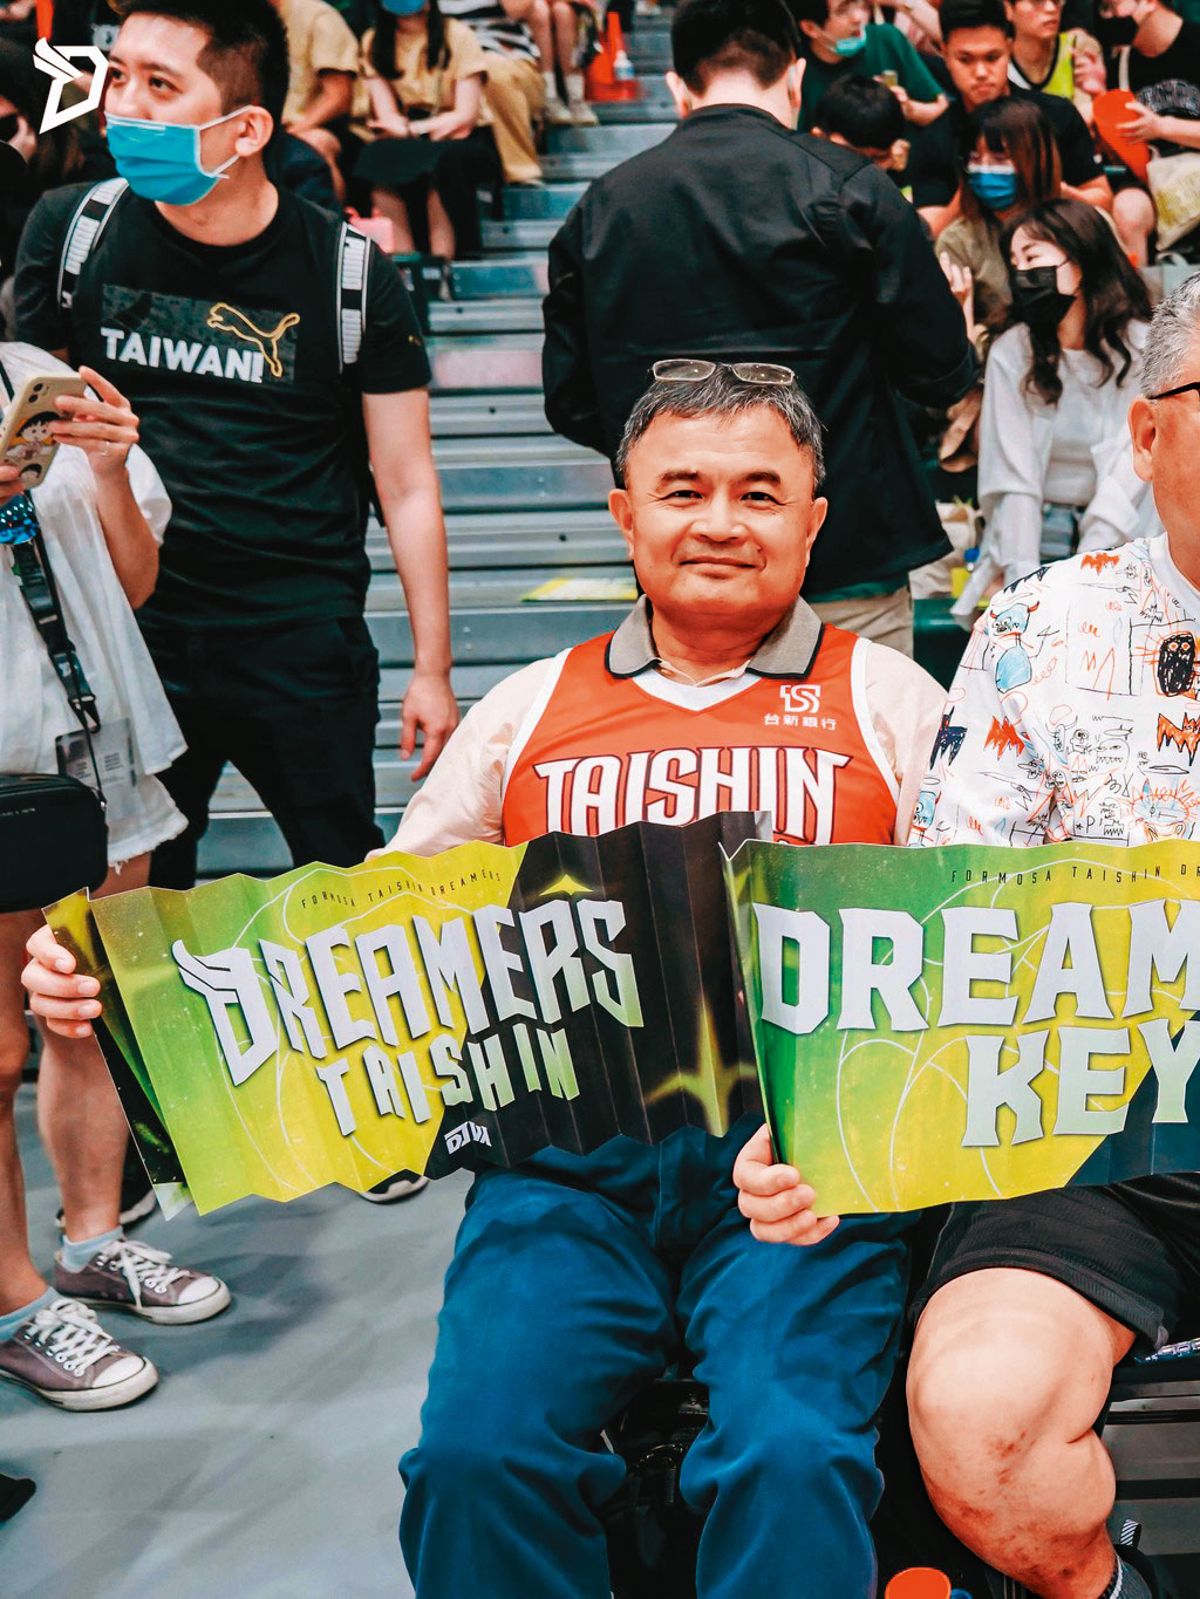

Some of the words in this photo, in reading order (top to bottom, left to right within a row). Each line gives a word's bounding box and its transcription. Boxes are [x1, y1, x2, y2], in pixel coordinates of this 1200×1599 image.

[533, 746, 853, 846] TAISHIN
[367, 880, 424, 903] TAISHIN
[430, 868, 502, 897] DREAMERS
[951, 870, 1052, 886] FORMOSA
[1071, 866, 1161, 884] TAISHIN
[171, 899, 645, 1086] DREAMERS
[316, 1022, 581, 1137] TAISHIN
